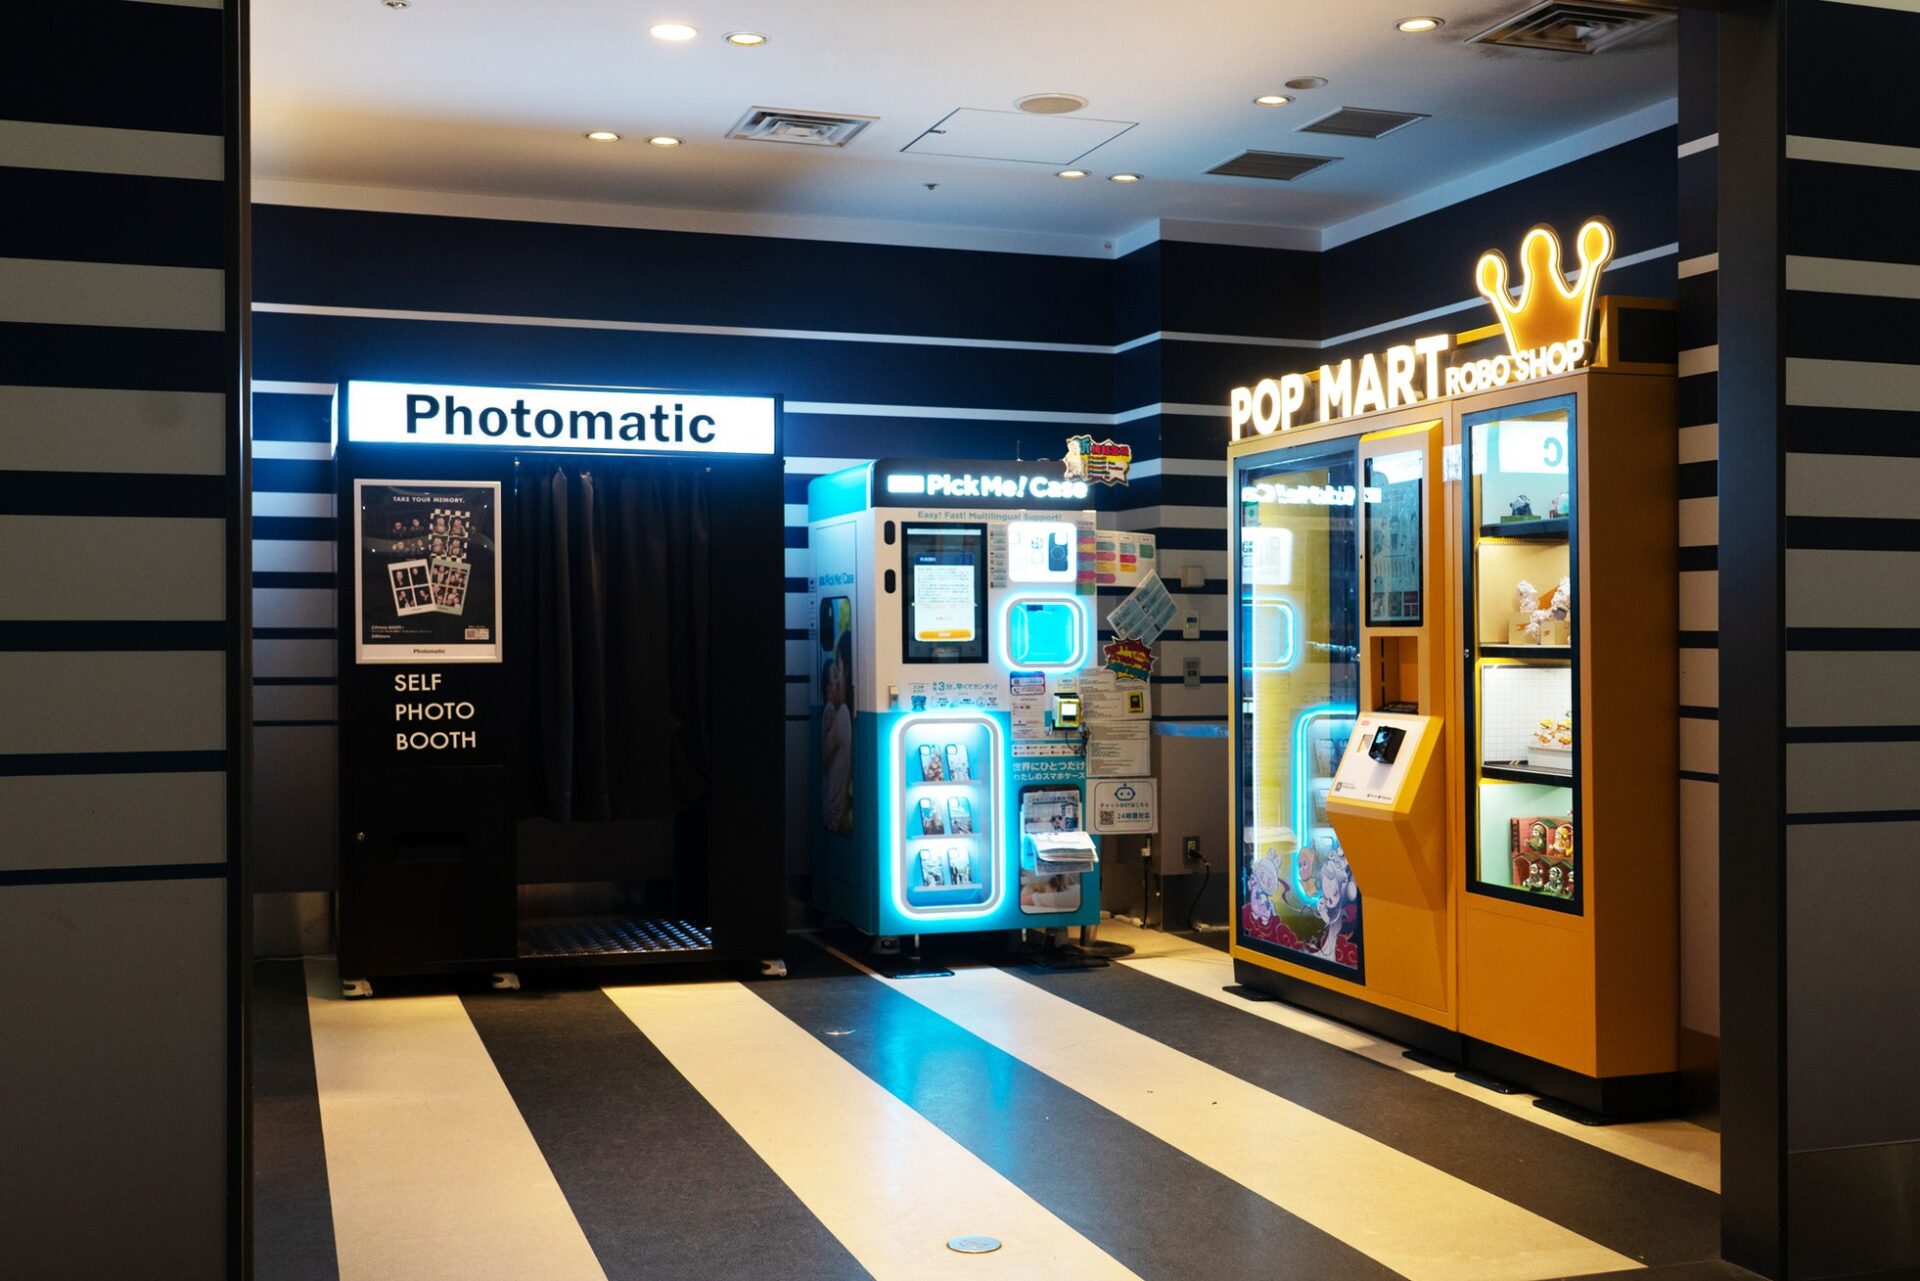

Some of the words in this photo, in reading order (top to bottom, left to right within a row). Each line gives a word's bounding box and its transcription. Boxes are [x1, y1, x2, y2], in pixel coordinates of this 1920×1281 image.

[1445, 354, 1511, 397] ROBO
[1514, 339, 1585, 382] SHOP
[1230, 373, 1305, 442] POP
[1319, 334, 1450, 423] MART
[406, 394, 716, 443] Photomatic
[926, 474, 981, 496] Pick
[1028, 476, 1088, 499] Case
[917, 510, 942, 520] Easy!
[944, 511, 966, 520] Fast!
[968, 511, 1021, 521] Multilingual
[1023, 513, 1062, 522] Support!
[394, 673, 442, 692] SELF
[395, 702, 475, 721] PHOTO
[396, 731, 476, 751] BOOTH
[1012, 761, 1086, 772] 世界にひとつだけ
[1013, 772, 1086, 781] わたしのスマホケース
